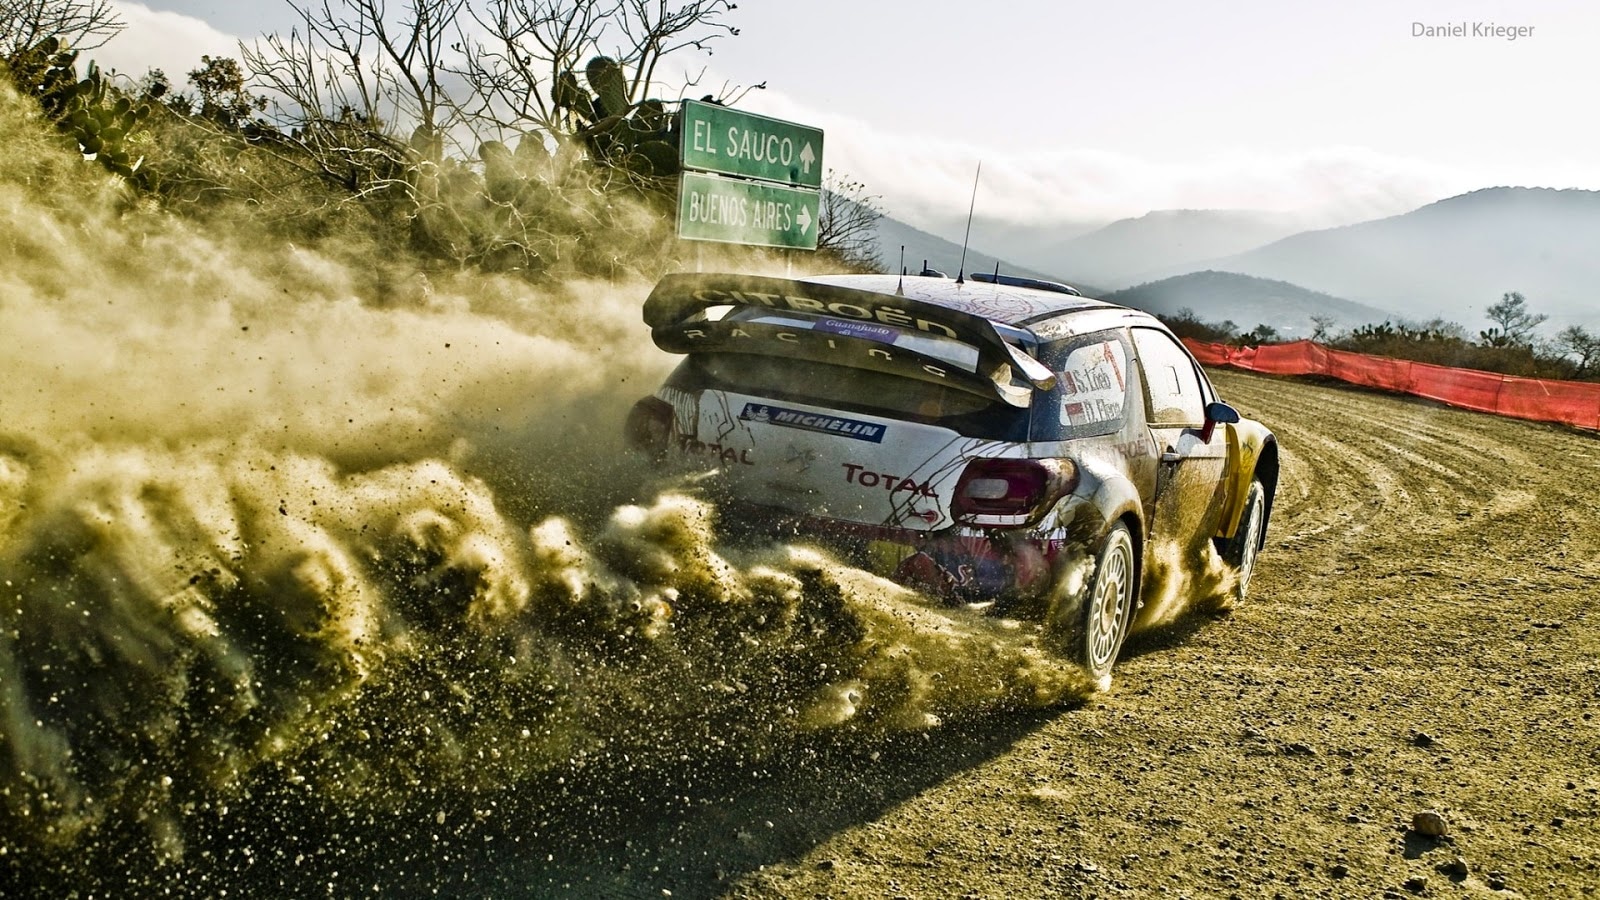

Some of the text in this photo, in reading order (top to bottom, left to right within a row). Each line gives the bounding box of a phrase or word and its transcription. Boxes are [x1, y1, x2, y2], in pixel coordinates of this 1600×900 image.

[693, 119, 793, 166] EL SAUCO
[689, 191, 792, 232] BUENOS AIRES
[825, 319, 891, 336] Guanajuato
[774, 406, 879, 437] MICHELIN
[841, 462, 940, 499] TOTAL
